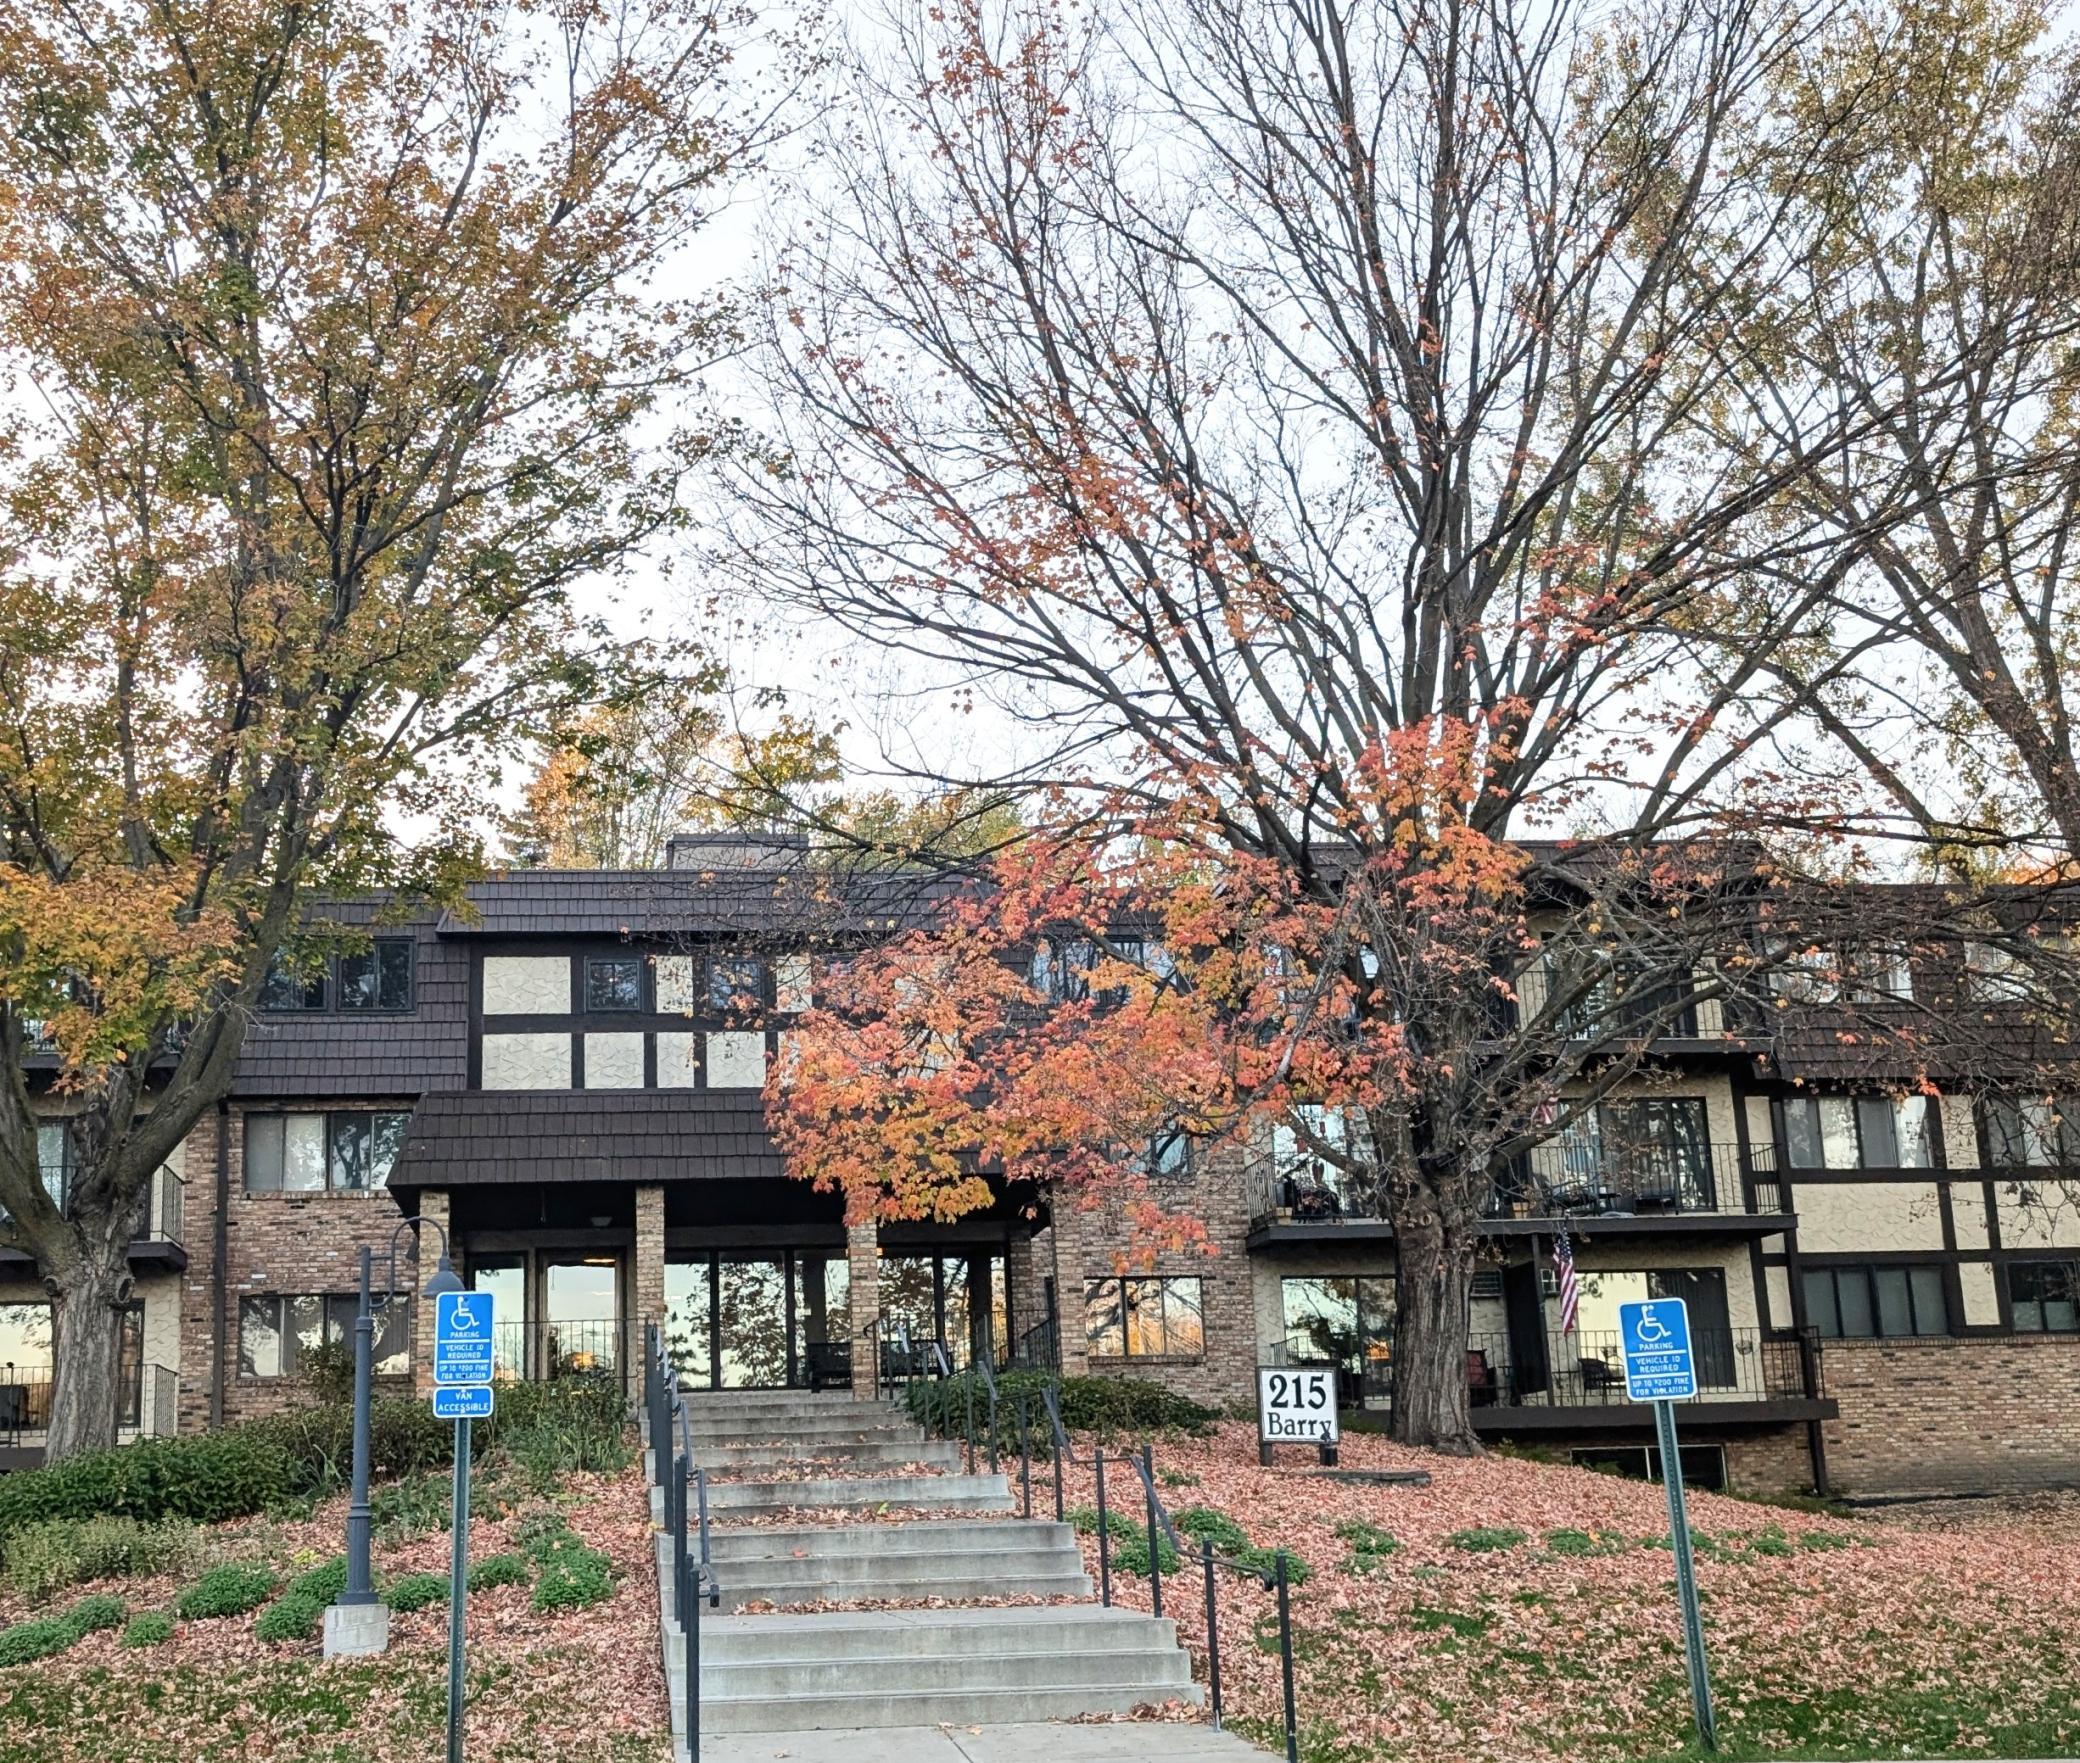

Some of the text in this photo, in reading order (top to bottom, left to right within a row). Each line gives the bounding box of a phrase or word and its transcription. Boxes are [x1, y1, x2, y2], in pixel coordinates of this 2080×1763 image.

[1638, 1342, 1673, 1351] PARKING
[1635, 1355, 1681, 1365] VEHICLE ID
[440, 1364, 448, 1372] UP
[449, 1364, 456, 1372] TO
[1639, 1364, 1679, 1373] REQUIRED
[1633, 1380, 1642, 1388] UP
[1644, 1379, 1652, 1387] TO
[1674, 1377, 1689, 1385] FINE
[1269, 1373, 1326, 1410] 215
[1636, 1386, 1689, 1396] FOR VIOLATION
[437, 1403, 489, 1412] ACCESSIBLE
[1267, 1411, 1332, 1441] Barry
